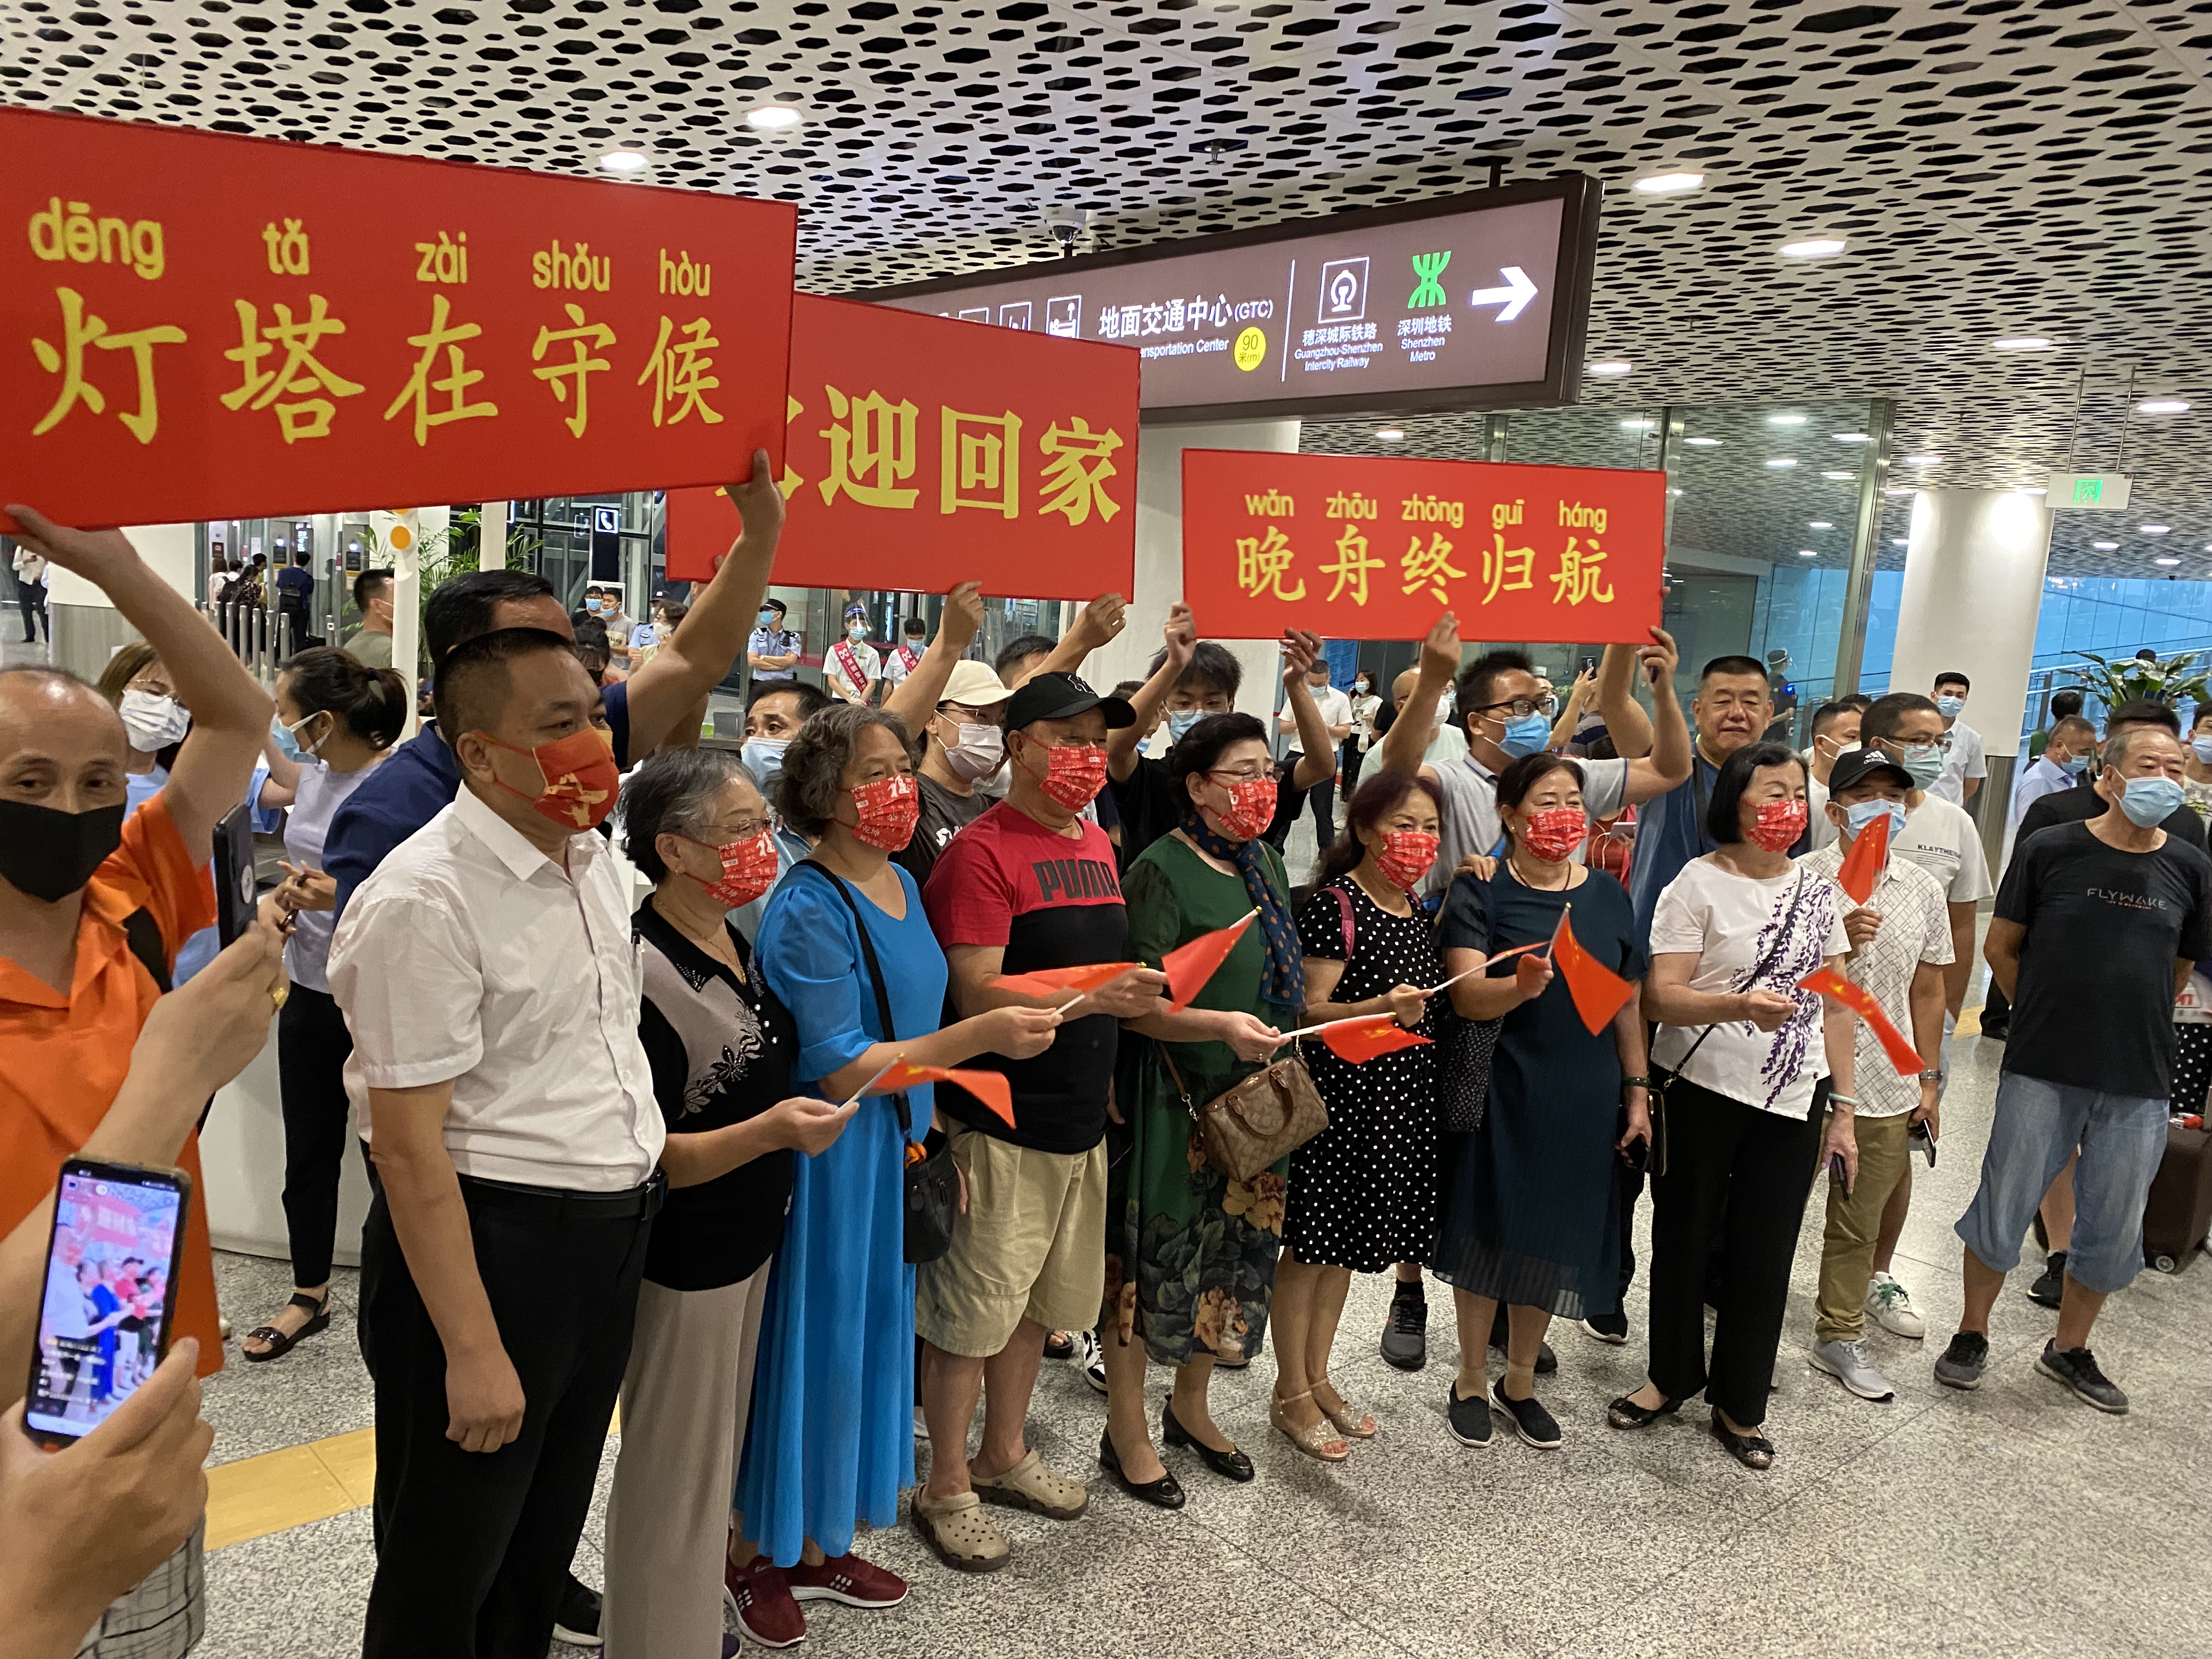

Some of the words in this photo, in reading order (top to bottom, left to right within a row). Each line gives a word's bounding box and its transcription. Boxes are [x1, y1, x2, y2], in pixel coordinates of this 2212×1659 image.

[29, 197, 165, 281] dēng
[415, 231, 468, 284] zài
[533, 239, 611, 292] shǒu
[659, 249, 710, 296] hòu
[1302, 321, 1377, 347] 穗深城际铁路
[1397, 314, 1452, 336] 深圳地铁
[1196, 338, 1229, 353] Center
[1243, 334, 1259, 351] 90
[1294, 341, 1383, 360] Guangzhou-Shenzhen
[1401, 336, 1445, 350] Shenzhen
[31, 286, 725, 445] 灯塔在守候
[1304, 359, 1335, 371] Intercity
[1336, 356, 1370, 369] Railway
[1409, 350, 1436, 363] Metro
[715, 385, 1124, 526] 迎回家
[1245, 489, 1294, 517] wǎn
[1326, 492, 1378, 520] zhōu
[1402, 494, 1464, 529] zhōng
[1492, 499, 1526, 530] guī
[1559, 500, 1607, 534] háng
[1236, 524, 1615, 607] 晚舟终归航
[1032, 859, 1121, 902] PUMA
[2087, 888, 2167, 911] FLYWAKE
